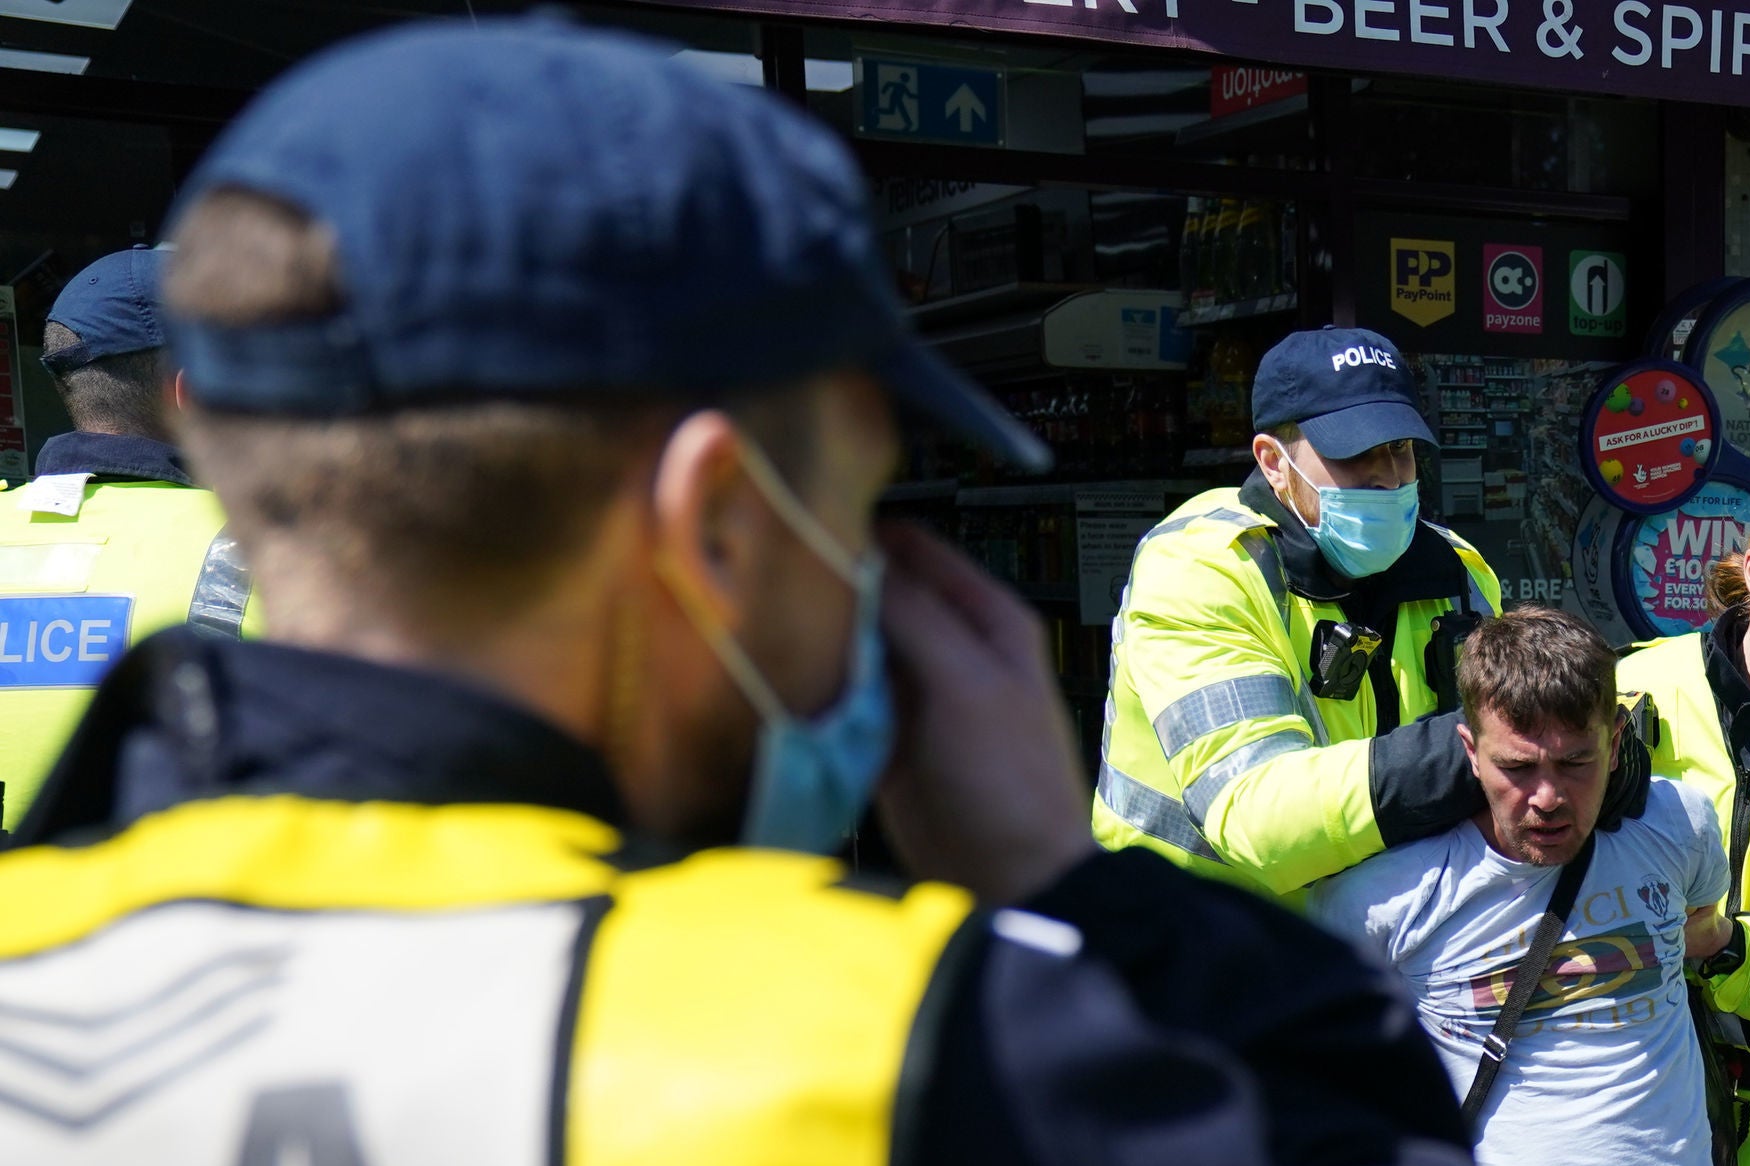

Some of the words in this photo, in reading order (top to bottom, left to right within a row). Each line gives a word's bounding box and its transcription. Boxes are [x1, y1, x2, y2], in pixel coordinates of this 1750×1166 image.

[1293, 0, 1511, 53] BEER
[1535, 0, 1584, 61] &
[1222, 67, 1304, 106] motion
[1396, 288, 1452, 302] PayPoint
[1486, 314, 1541, 329] payzone
[1573, 316, 1624, 332] top-up
[1332, 345, 1396, 373] POLICE
[1606, 435, 1624, 447] ASK
[1624, 432, 1642, 444] FOR
[1642, 431, 1649, 440] A
[1650, 424, 1678, 438] LUCKY
[1702, 496, 1721, 505] FOR
[1722, 497, 1742, 506] LIFE
[1501, 578, 1513, 600] &
[1665, 583, 1705, 596] EVERY
[1664, 597, 1690, 610] FOR
